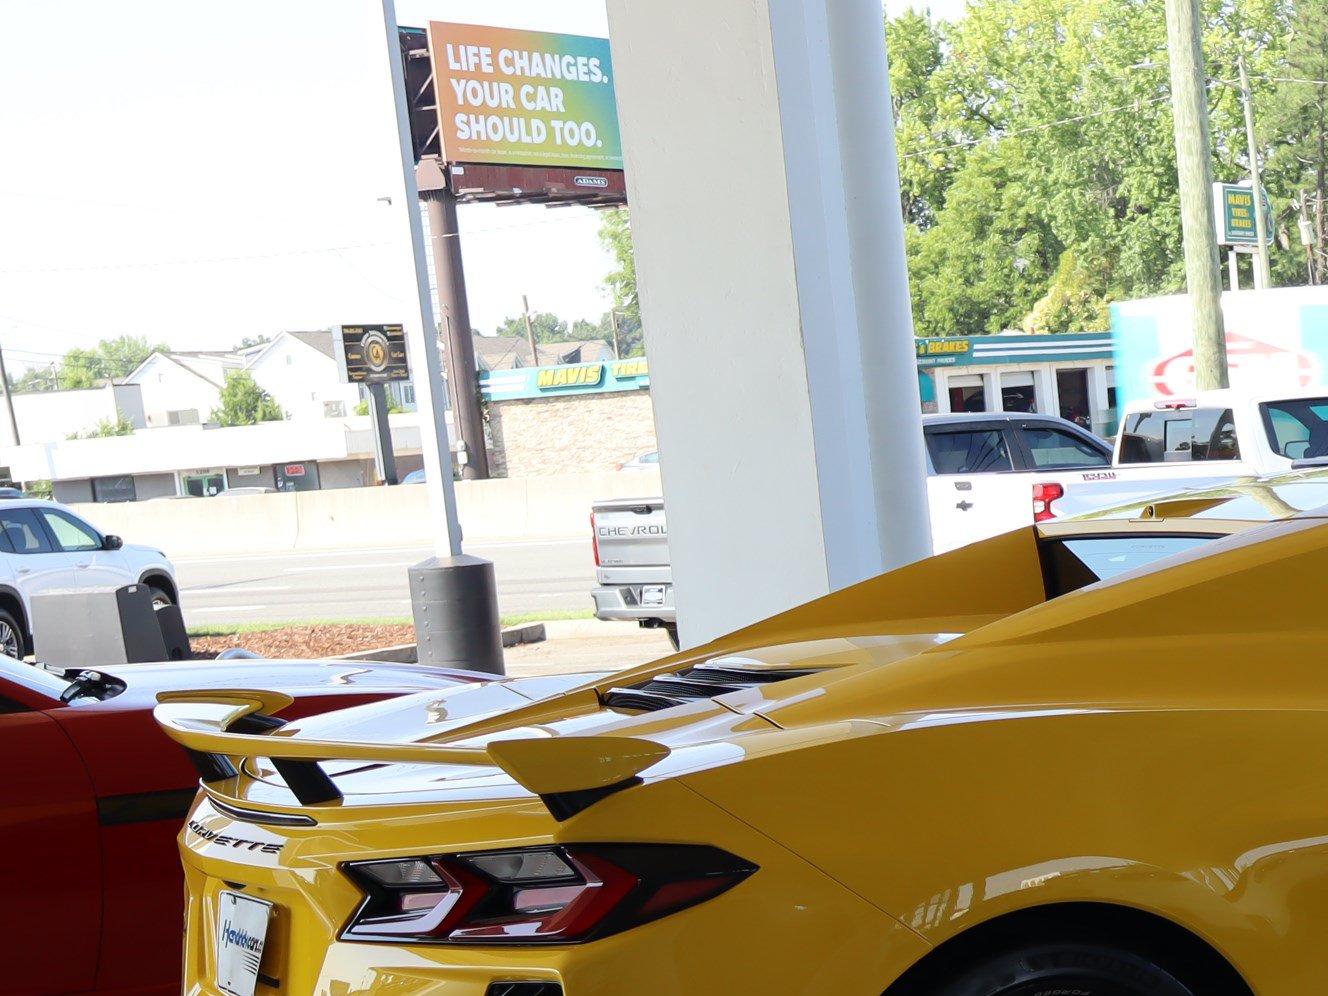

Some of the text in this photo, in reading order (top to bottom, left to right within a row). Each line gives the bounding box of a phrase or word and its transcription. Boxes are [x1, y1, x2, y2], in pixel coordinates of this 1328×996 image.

[446, 43, 609, 84] LIFE CHANGES.
[450, 79, 565, 112] YOUR CAR
[455, 113, 603, 148] SHOULD TOO.
[1228, 194, 1251, 206] MAVIS
[928, 340, 969, 354] BRAKES
[537, 365, 601, 386] MAVIS
[188, 820, 285, 854] CORVETTE
